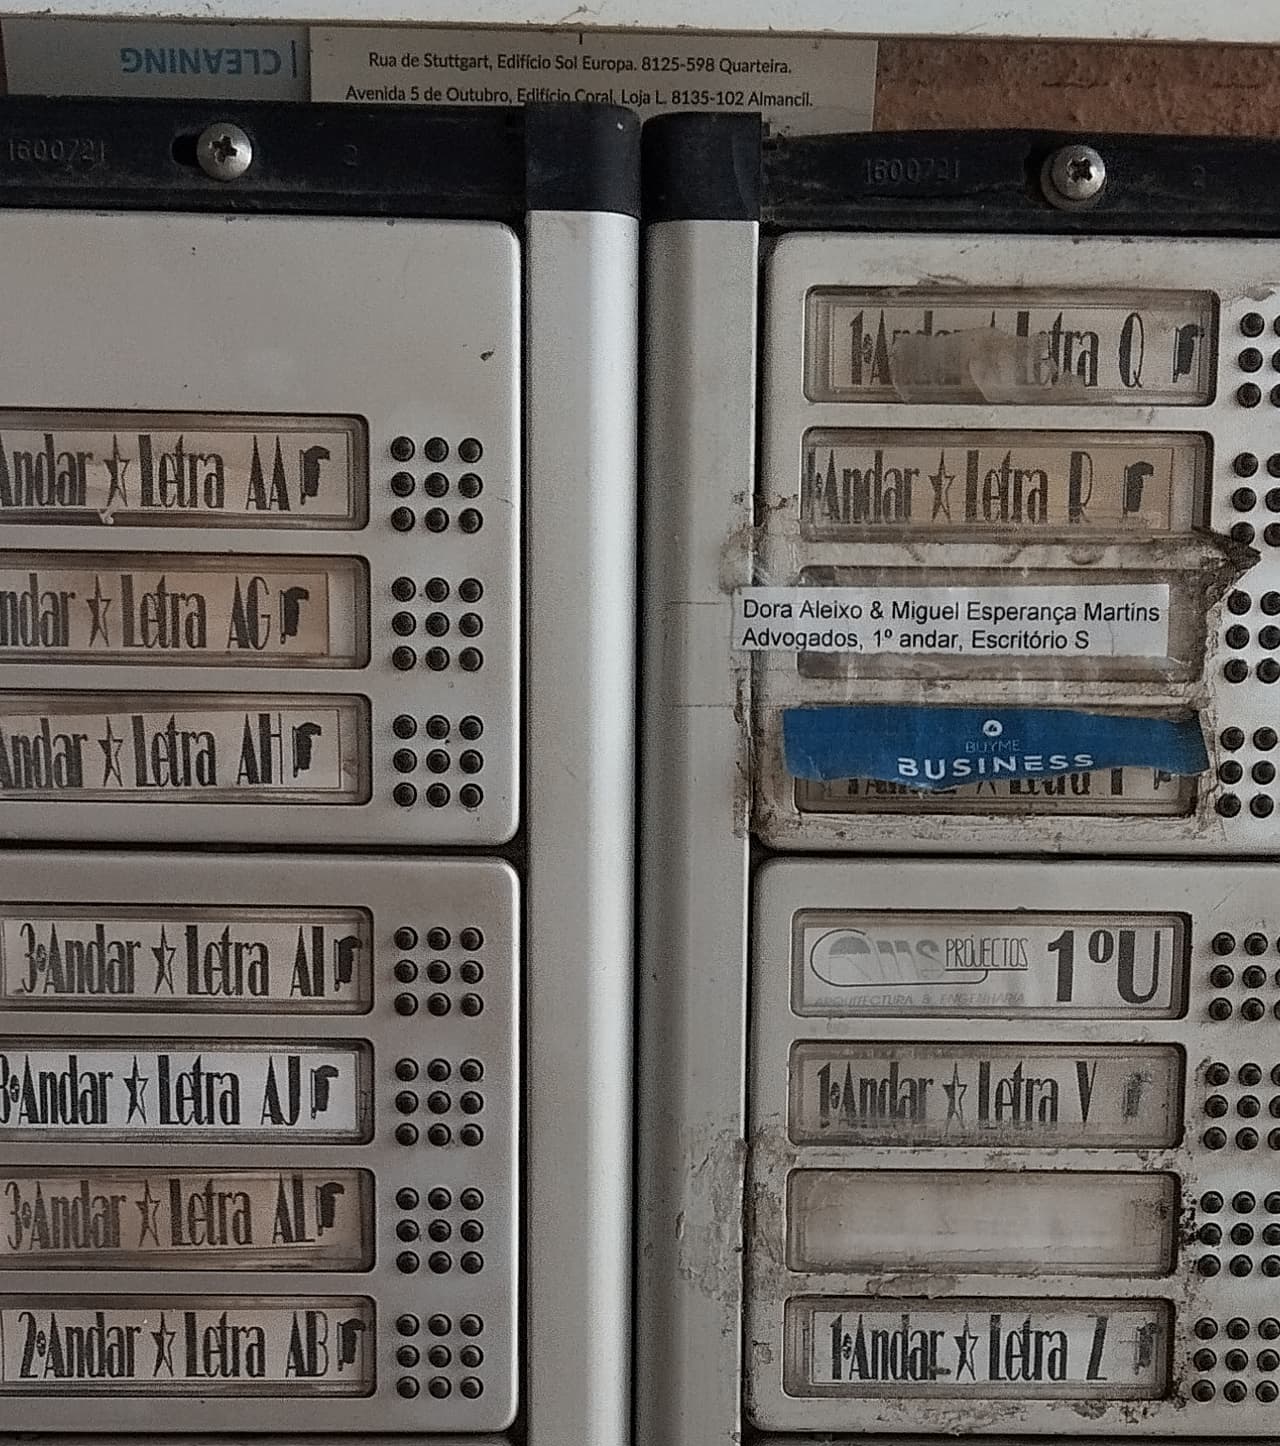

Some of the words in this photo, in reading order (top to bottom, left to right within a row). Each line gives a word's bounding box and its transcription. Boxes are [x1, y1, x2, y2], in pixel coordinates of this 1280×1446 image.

[121, 47, 282, 76] CLEANING
[369, 52, 397, 68] Rua
[401, 53, 419, 68] de
[424, 53, 493, 71] Stuttgart,
[497, 54, 551, 70] Edifício
[555, 55, 578, 70] Sol
[583, 55, 637, 72] Europa.
[641, 56, 715, 72] 8125-598
[719, 58, 792, 75] Quarteira.
[345, 85, 405, 101] Avenida
[410, 86, 419, 101] 5
[423, 86, 442, 101] de
[446, 86, 513, 104] Outubro,
[517, 87, 570, 102] Edifício
[621, 90, 651, 108] Loja
[655, 91, 667, 105] L.
[672, 91, 744, 106] 8135-102
[748, 91, 813, 107] Almancil.
[138, 434, 225, 509] Letra
[246, 434, 291, 511] AA
[965, 449, 1048, 525] Letra
[120, 573, 207, 650] Letra
[226, 575, 272, 651] AG
[742, 630, 863, 650] Advogados,
[872, 631, 893, 648] 1º
[899, 631, 963, 651] andar,
[971, 629, 1068, 649] Escritório
[1074, 630, 1090, 649] S
[743, 600, 793, 619] Dora
[799, 600, 863, 620] Aleixo
[870, 601, 884, 620] &
[891, 601, 959, 626] Miguel
[967, 601, 1077, 626] Esperança
[1083, 601, 1160, 622] Martins
[131, 714, 217, 787] Letra
[237, 712, 283, 785] AH
[897, 753, 1094, 781] BUSINESS
[185, 924, 269, 997] Letra
[158, 1054, 241, 1126] Letra
[261, 1055, 302, 1126] AJ
[978, 1061, 1059, 1130] Letra
[1075, 1060, 1098, 1130] V
[169, 1177, 253, 1247] Letra
[271, 1173, 315, 1245] AL
[185, 1311, 266, 1379] Letra
[285, 1310, 329, 1379] AB
[989, 1313, 1068, 1381] Letra
[1085, 1314, 1109, 1381] Z
